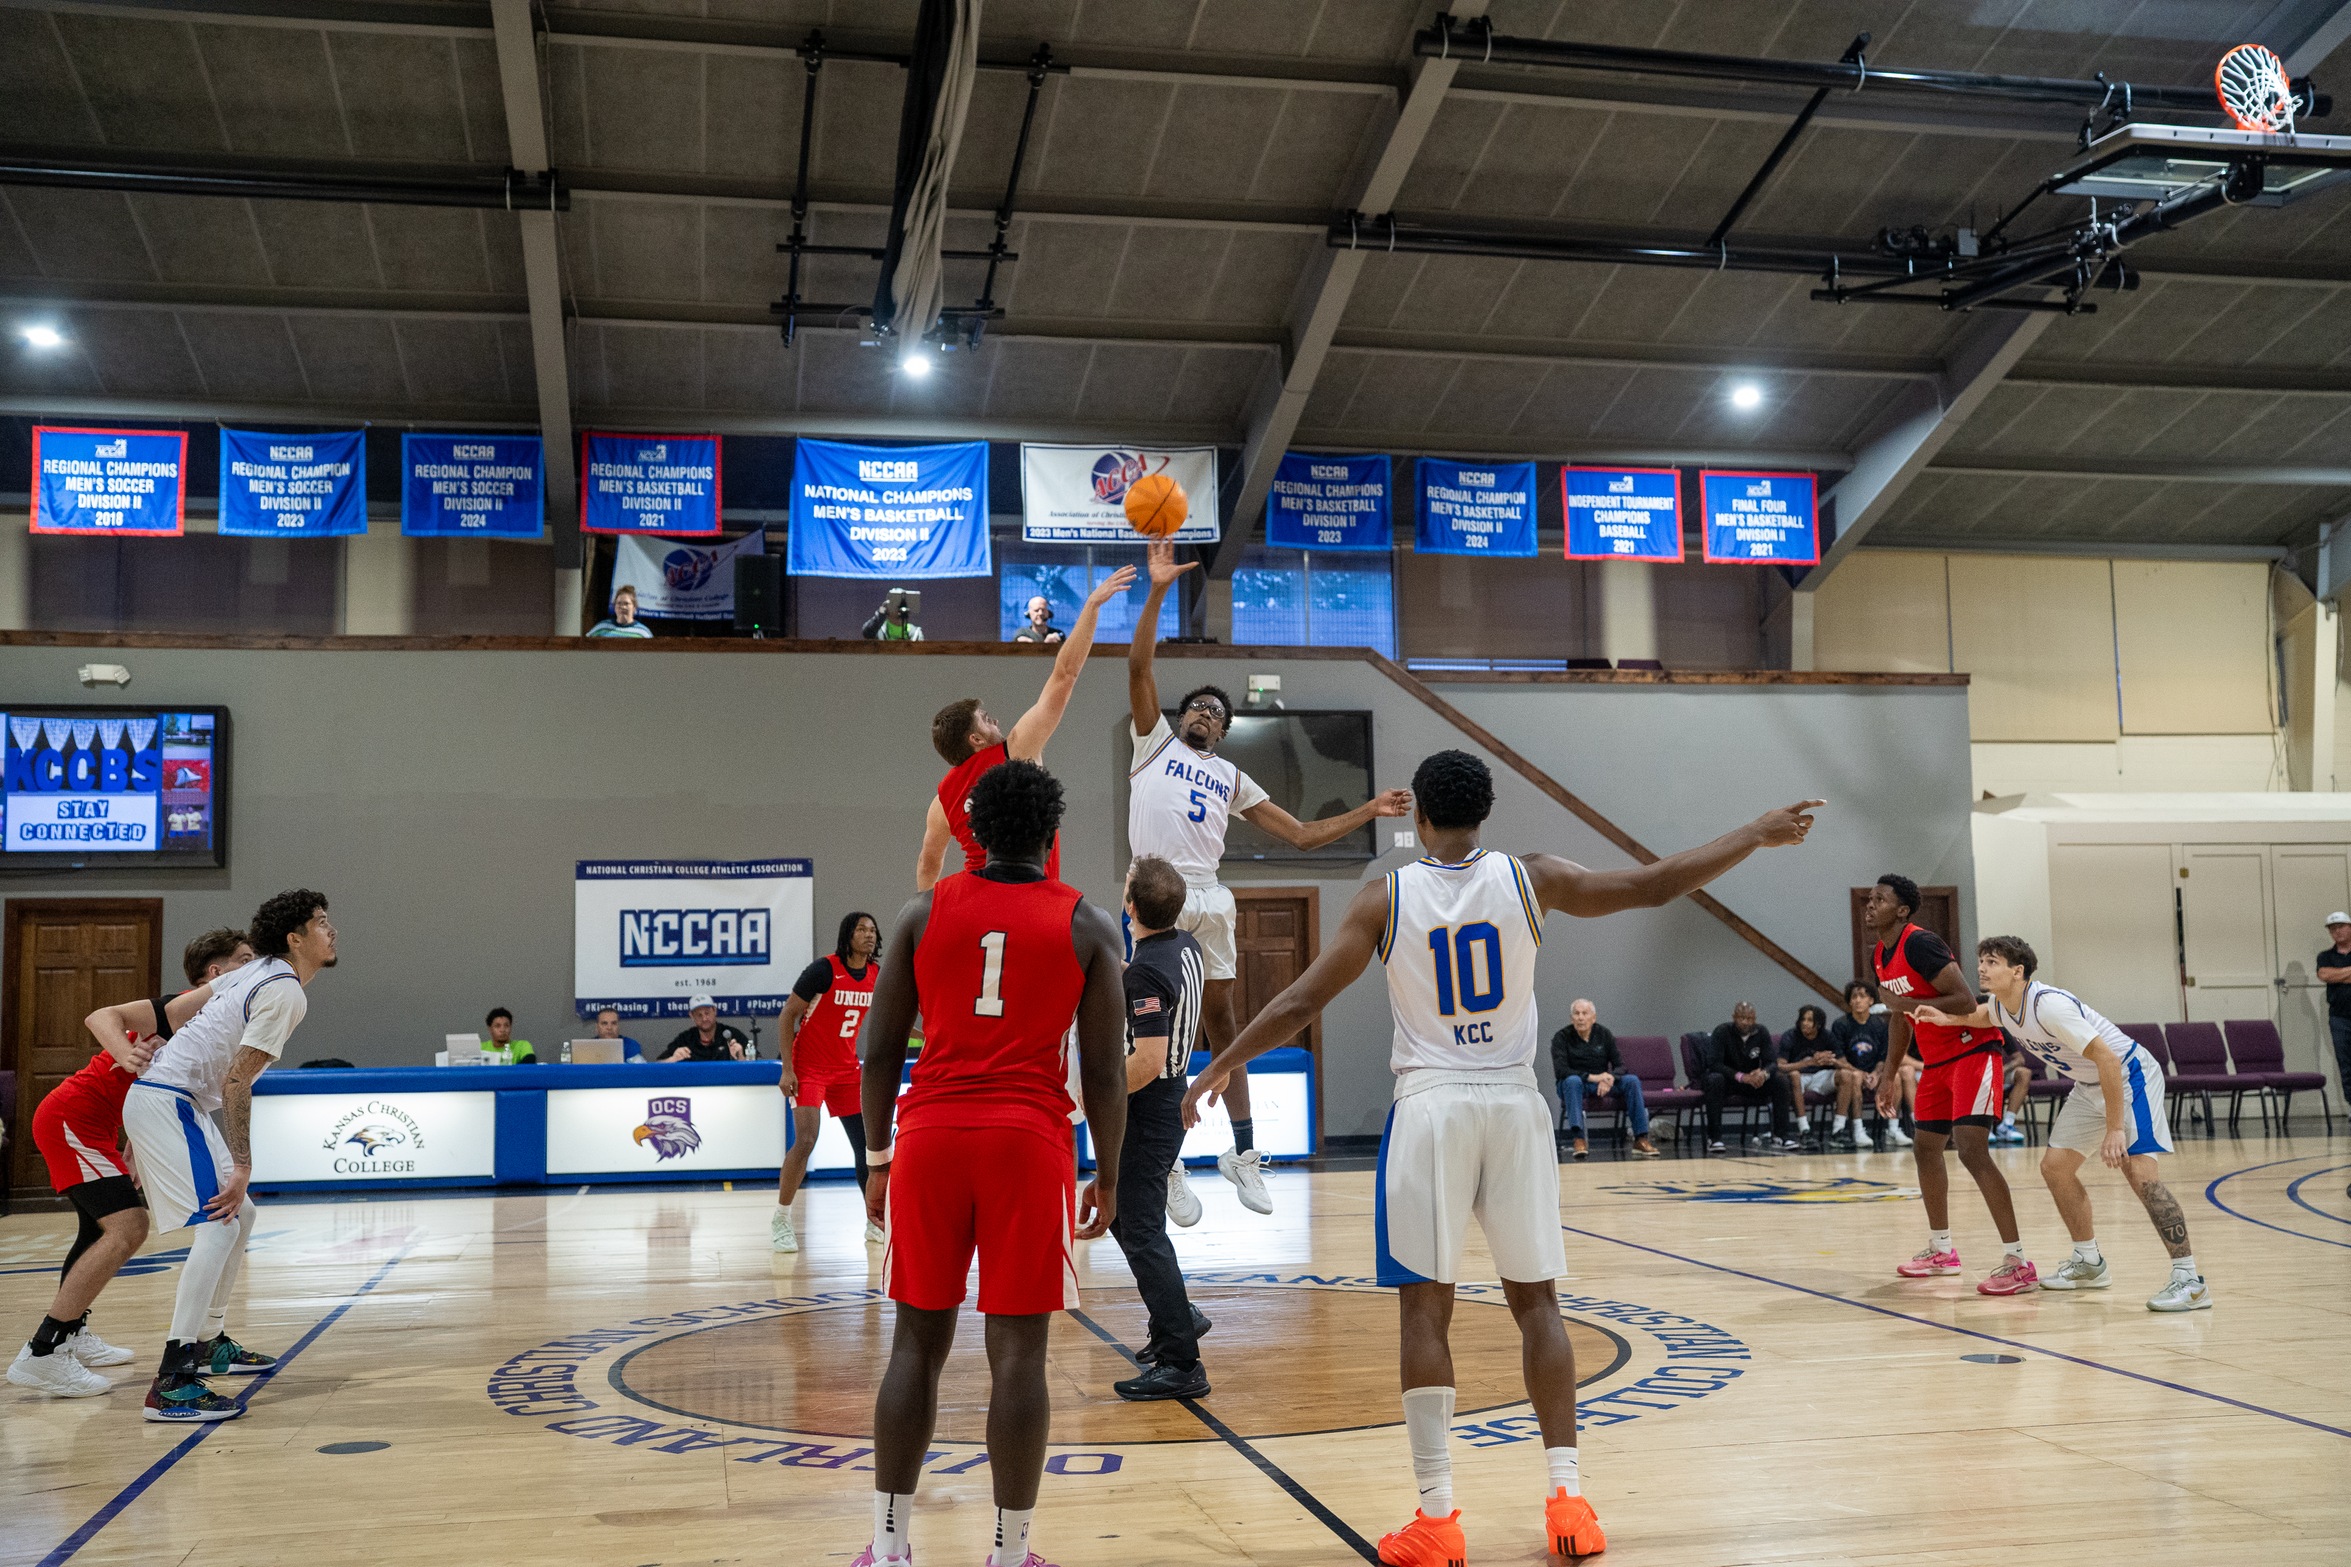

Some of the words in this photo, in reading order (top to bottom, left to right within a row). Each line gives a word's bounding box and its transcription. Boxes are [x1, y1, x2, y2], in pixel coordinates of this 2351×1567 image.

[270, 445, 313, 461] NCCAA
[453, 445, 495, 460] NCCAA
[44, 459, 103, 475] REGIONAL
[106, 461, 177, 478] CHAMPIONS
[231, 461, 288, 480] REGIONAL
[291, 462, 350, 478] CHAMPION
[415, 464, 470, 478] REGIONAL
[473, 466, 532, 479] CHAMPION
[591, 463, 645, 478] REGIONAL
[648, 464, 713, 479] CHAMPIONS
[859, 460, 918, 480] NCCAA
[1311, 465, 1348, 479] NCCAA
[65, 477, 104, 492] MEN'S
[107, 478, 154, 493] SOCCER
[1458, 471, 1495, 485] NCCAA
[249, 479, 285, 494] MEN'S
[288, 480, 333, 494] SOCCER
[432, 481, 468, 494] MEN'S
[471, 481, 514, 495] SOCCER
[599, 480, 635, 493] MEN'S
[637, 481, 704, 495] BASKETBALL
[805, 484, 879, 504] NATIONAL
[882, 488, 973, 504] CHAMPIONS
[1274, 480, 1323, 497] REGIONAL
[1325, 483, 1383, 497] CHAMPIONS
[78, 493, 130, 508] DIVISION
[133, 495, 142, 509] II
[1427, 486, 1474, 504] REGIONAL
[1475, 491, 1526, 504] CHAMPION
[1568, 495, 1620, 508] INDEPENDENT
[1621, 496, 1674, 510] TOURNAMENT
[260, 496, 311, 510] DIVISION
[313, 496, 321, 510] II
[443, 497, 492, 510] DIVISION
[494, 498, 503, 510] II
[622, 496, 671, 509] DIVISION
[673, 497, 682, 510] II
[1281, 497, 1314, 511] MEN'S
[1316, 498, 1377, 512] BASKETBALL
[1431, 501, 1461, 516] MEN'S
[1463, 504, 1521, 520] BASKETBALL
[1732, 499, 1758, 512] FINAL
[1761, 499, 1786, 513] FOUR
[95, 512, 123, 527] 2018
[277, 512, 305, 527] 2023
[460, 513, 486, 527] 2024
[639, 513, 664, 526] 2021
[813, 505, 861, 521] MEN'S
[864, 508, 964, 523] BASKETBALL
[1049, 510, 1089, 519] Association
[1303, 514, 1347, 528] DIVISION
[1349, 516, 1356, 527] II
[1594, 510, 1651, 524] CHAMPIONS
[1715, 513, 1744, 527] MEN'S
[1747, 514, 1804, 529] BASKETBALL
[1452, 518, 1493, 532] DIVISION
[1496, 521, 1502, 533] II
[1599, 525, 1646, 539] BASEBALL
[850, 527, 917, 541] DIVISION
[920, 528, 929, 541] II
[1030, 528, 1050, 537] 2023
[1052, 528, 1078, 538] Men's
[1080, 528, 1116, 538] National
[1168, 529, 1212, 540] hampions
[1318, 530, 1342, 543] 2023
[1465, 535, 1488, 548] 2024
[1736, 528, 1777, 541] DIVISION
[1779, 530, 1786, 542] II
[1613, 539, 1634, 553] 2021
[1750, 543, 1773, 556] 2021
[872, 548, 907, 561] 2023
[6, 748, 160, 792] KCCBS
[1164, 758, 1230, 803] FALCONS
[57, 800, 109, 819] STAY
[1187, 789, 1207, 823] 5
[20, 822, 146, 841] CONNECTED
[586, 865, 626, 875] NATIONAL
[629, 865, 673, 874] CHRISTIAN
[675, 865, 709, 875] COLLEGE
[711, 865, 749, 875] ATHLETIC
[751, 863, 803, 874] ASSOCIATION
[620, 909, 770, 958] NCCAA
[974, 930, 1007, 1017] 1
[1427, 919, 1506, 1017] 10
[674, 979, 692, 987] est.
[696, 978, 716, 987] 1968
[834, 989, 874, 1007] UNION
[839, 1009, 860, 1038] 2
[1453, 1021, 1494, 1046] KCC
[651, 1098, 687, 1116] OCS
[322, 1106, 365, 1151] KANSAS
[367, 1100, 425, 1150] CHRISTIAN
[333, 1157, 415, 1174] COLLEGE
[1182, 1272, 1504, 1295] KANSS
[487, 1328, 658, 1417] CHRISTIAN
